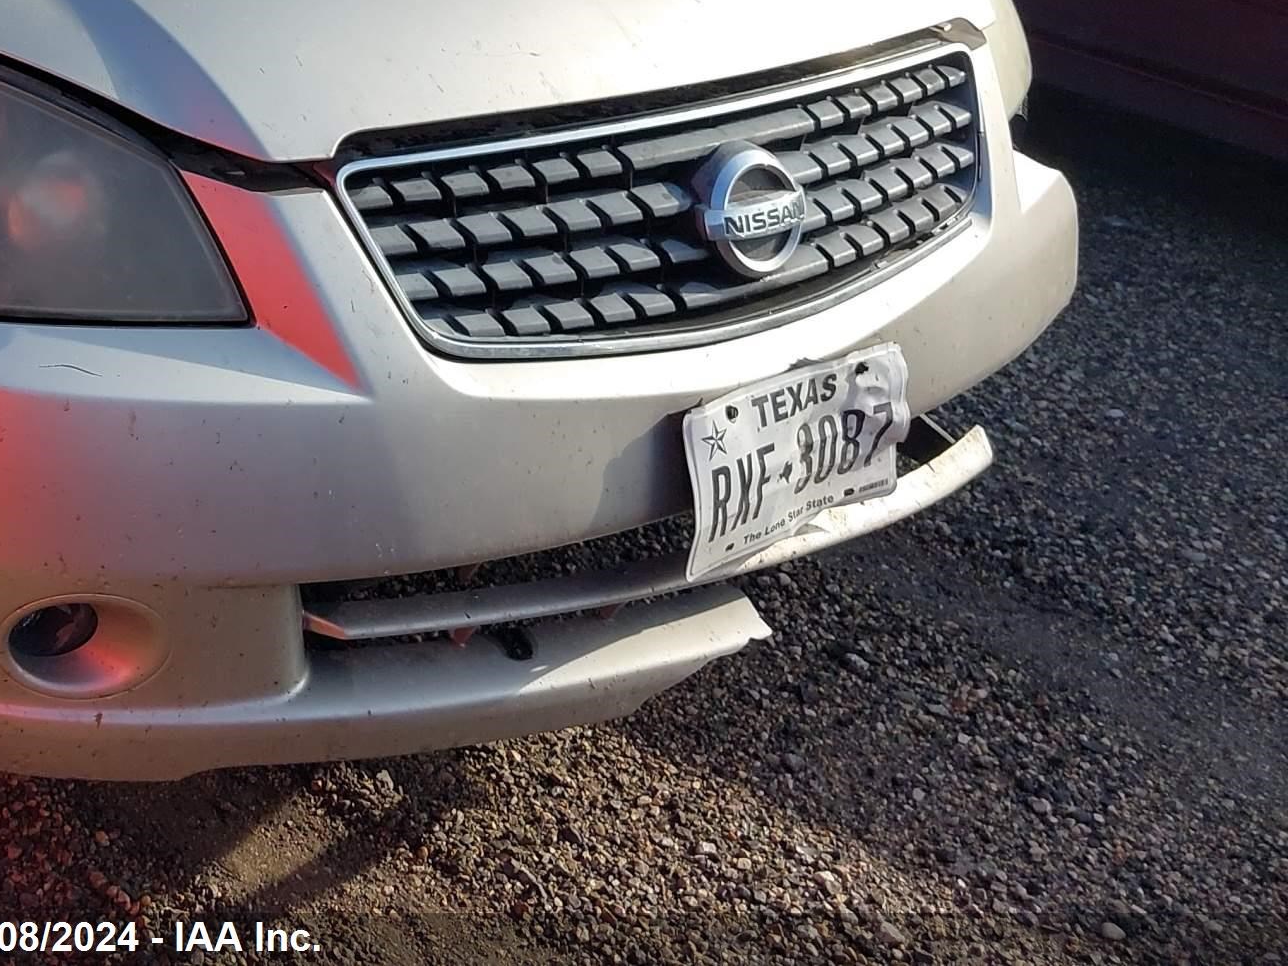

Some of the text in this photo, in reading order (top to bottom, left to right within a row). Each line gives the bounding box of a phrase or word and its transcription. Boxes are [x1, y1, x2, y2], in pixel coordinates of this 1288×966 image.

[723, 199, 805, 236] NISSAN
[751, 373, 837, 430] TEXAS
[708, 401, 894, 544] RXF 3087
[743, 494, 834, 545] The Lone Star State
